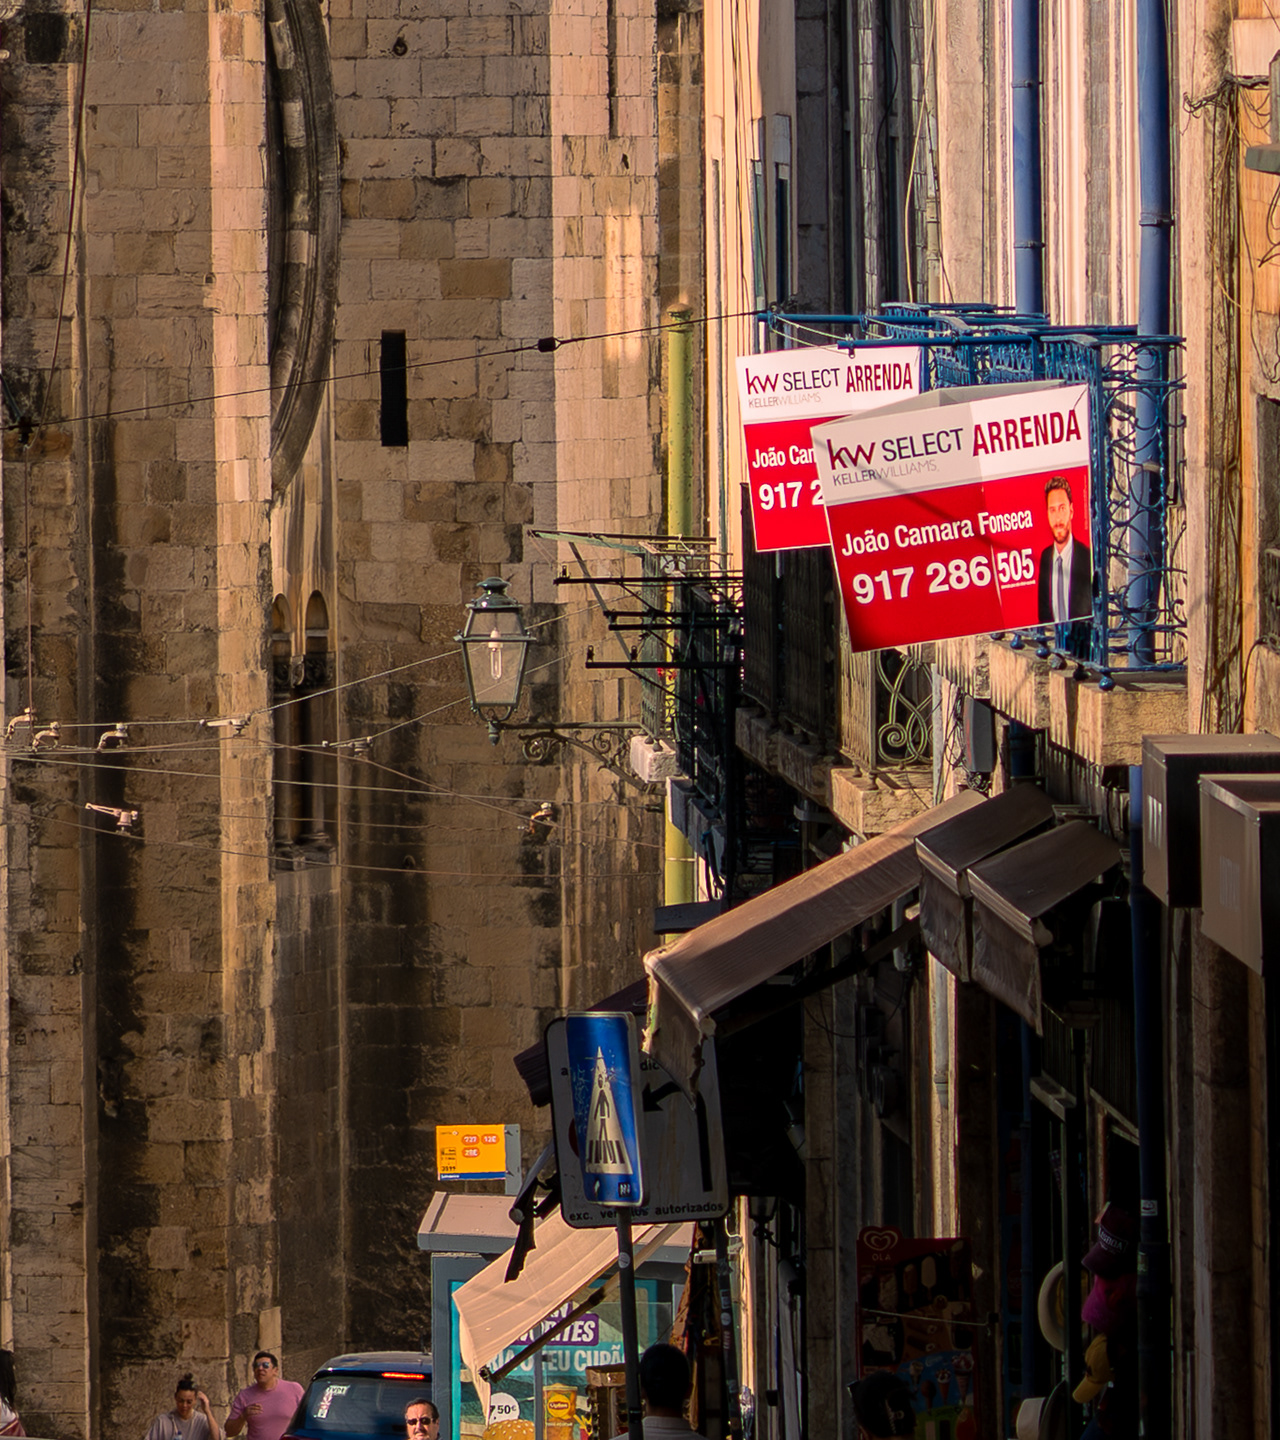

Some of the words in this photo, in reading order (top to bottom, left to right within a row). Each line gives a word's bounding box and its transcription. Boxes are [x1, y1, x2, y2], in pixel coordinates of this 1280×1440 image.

[745, 368, 779, 395] kw
[783, 368, 840, 391] SELECT
[846, 363, 913, 393] ARRENDA
[827, 439, 876, 470] kw
[881, 428, 963, 462] SELECT
[972, 409, 1081, 457] ARRENDA
[752, 447, 786, 468] João
[759, 482, 803, 510] 917
[842, 529, 890, 556] João
[894, 520, 975, 548] Camara
[978, 509, 1033, 536] Fonseca
[852, 566, 914, 604] 917
[926, 555, 992, 594] 286
[997, 548, 1035, 583] 505
[654, 1201, 723, 1216] autorizados
[574, 1344, 624, 1372] CUPÃ
